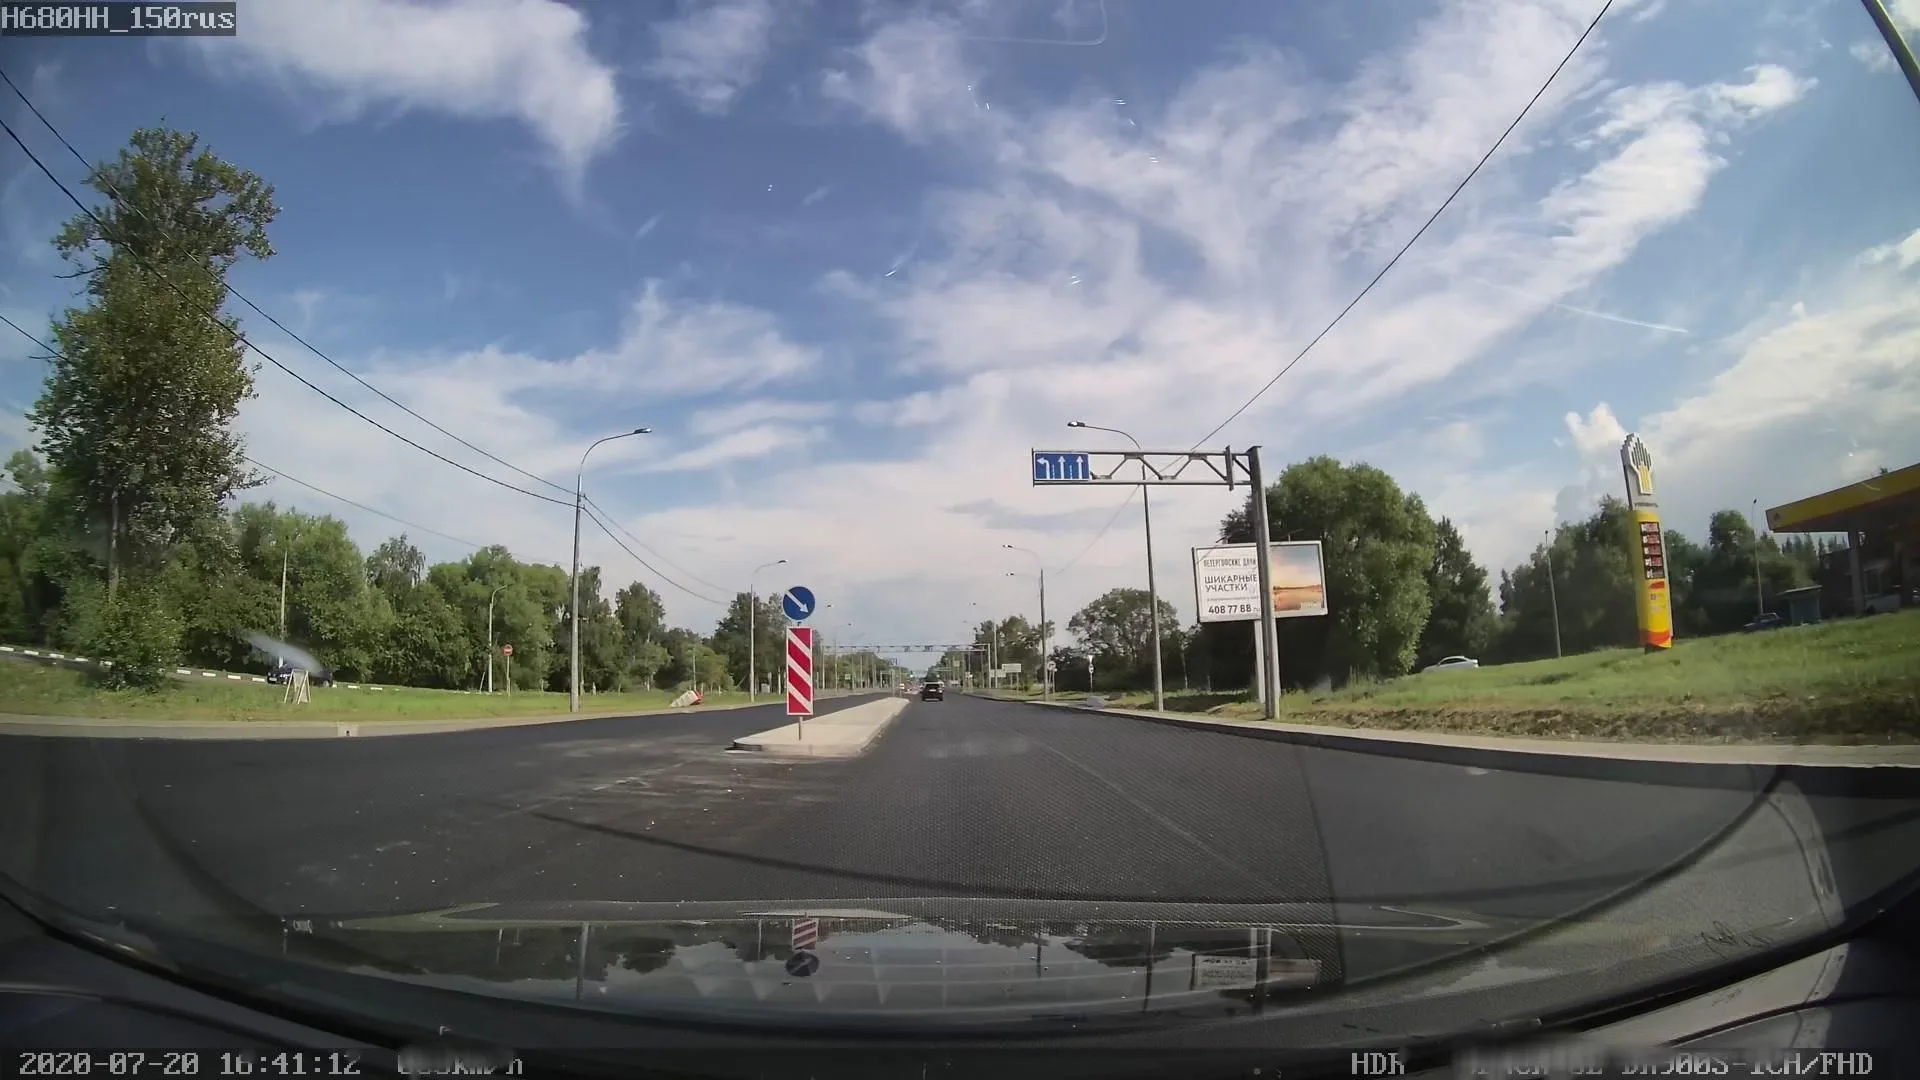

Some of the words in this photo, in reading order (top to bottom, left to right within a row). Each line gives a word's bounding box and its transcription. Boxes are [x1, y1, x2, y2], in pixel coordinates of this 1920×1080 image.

[1205, 575, 1257, 583] ШИКАРНЫЕ
[1205, 584, 1248, 592] УЧАСТКИ
[1208, 605, 1226, 614] 408
[1227, 605, 1238, 613] 77
[1240, 604, 1252, 613] 88
